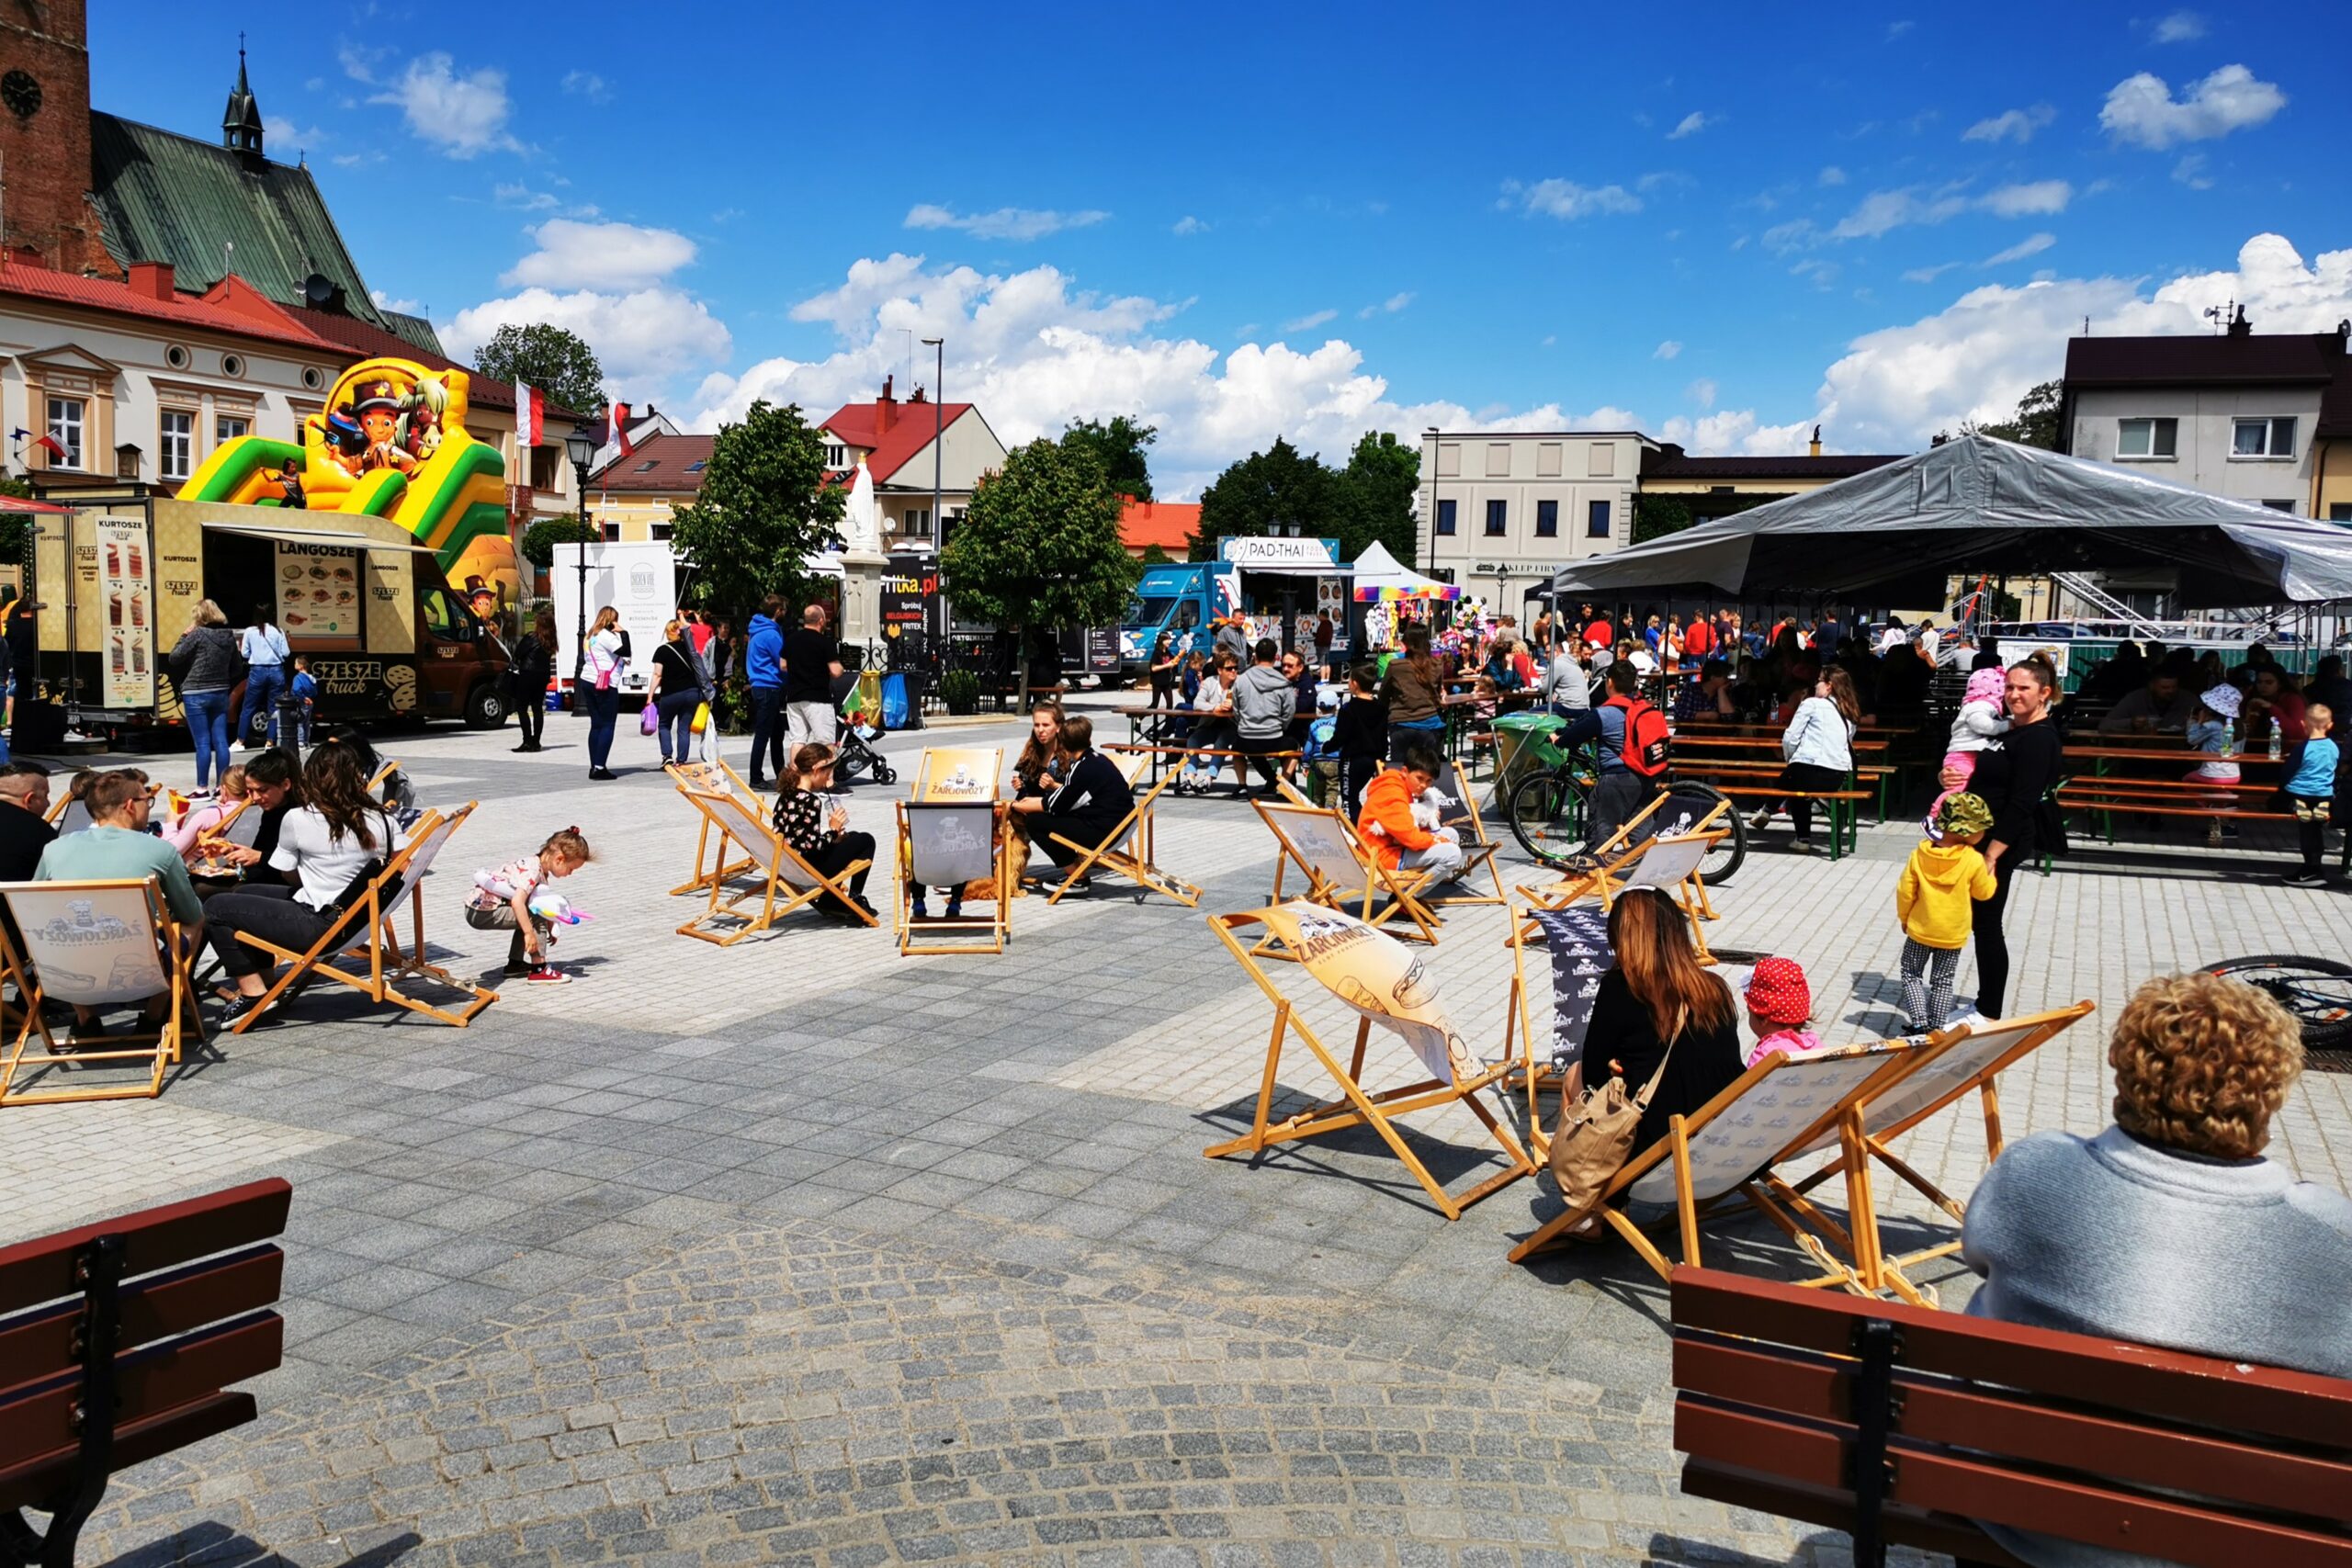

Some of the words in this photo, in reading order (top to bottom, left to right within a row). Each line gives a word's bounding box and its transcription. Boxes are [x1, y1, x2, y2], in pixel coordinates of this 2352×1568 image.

[98, 521, 142, 529] KURTOSZE
[278, 541, 356, 558] LANGOSZE
[1250, 543, 1305, 558] PAD-THAI
[164, 581, 198, 590] SZESZE
[901, 602, 922, 611] Spróbuj
[312, 661, 381, 680] SZESZE
[325, 678, 367, 694] truck
